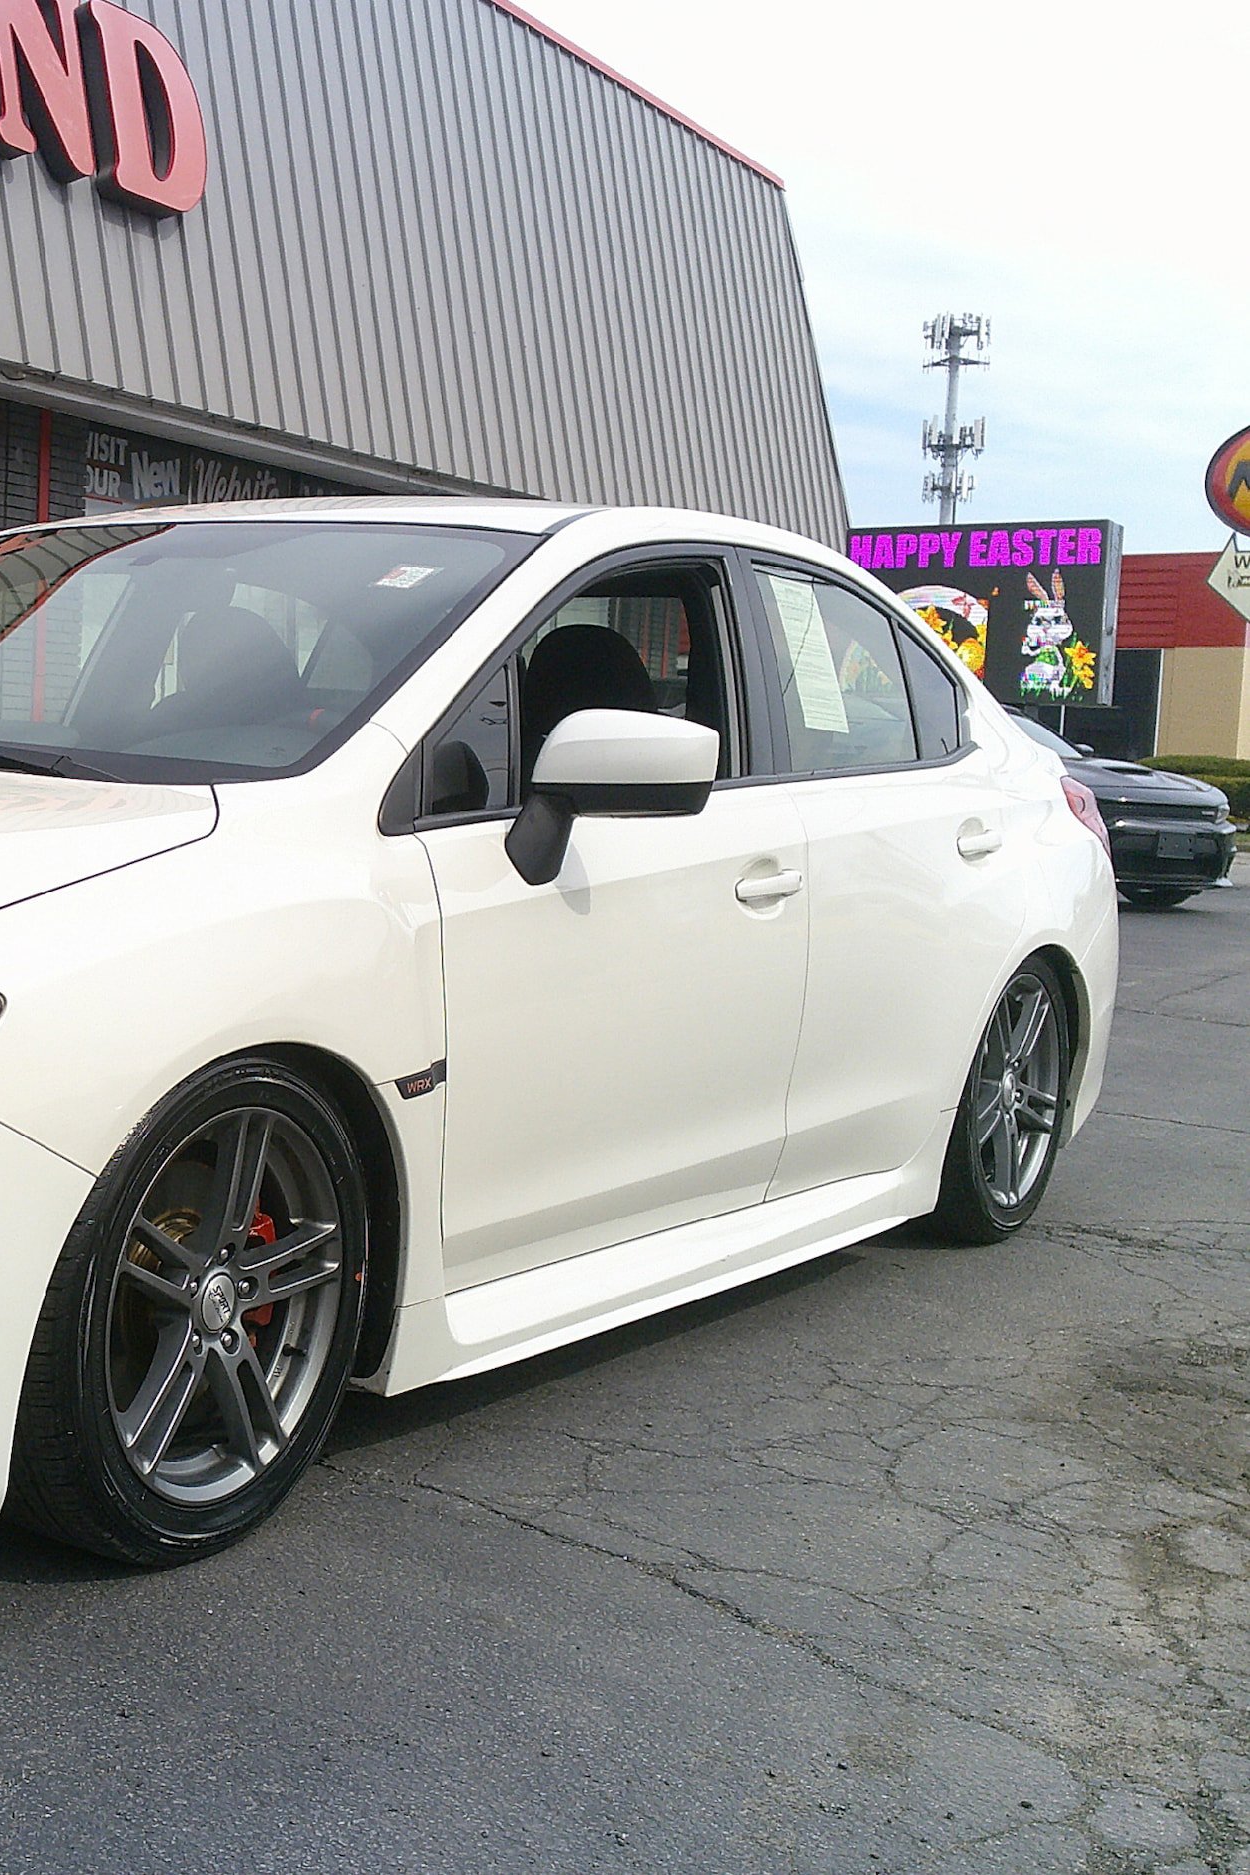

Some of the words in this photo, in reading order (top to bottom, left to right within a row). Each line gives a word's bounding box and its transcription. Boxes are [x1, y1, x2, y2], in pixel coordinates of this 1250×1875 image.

[131, 452, 181, 500] New
[850, 531, 963, 569] HAPPY
[968, 527, 1103, 567] EASTER
[406, 1076, 432, 1094] WRX
